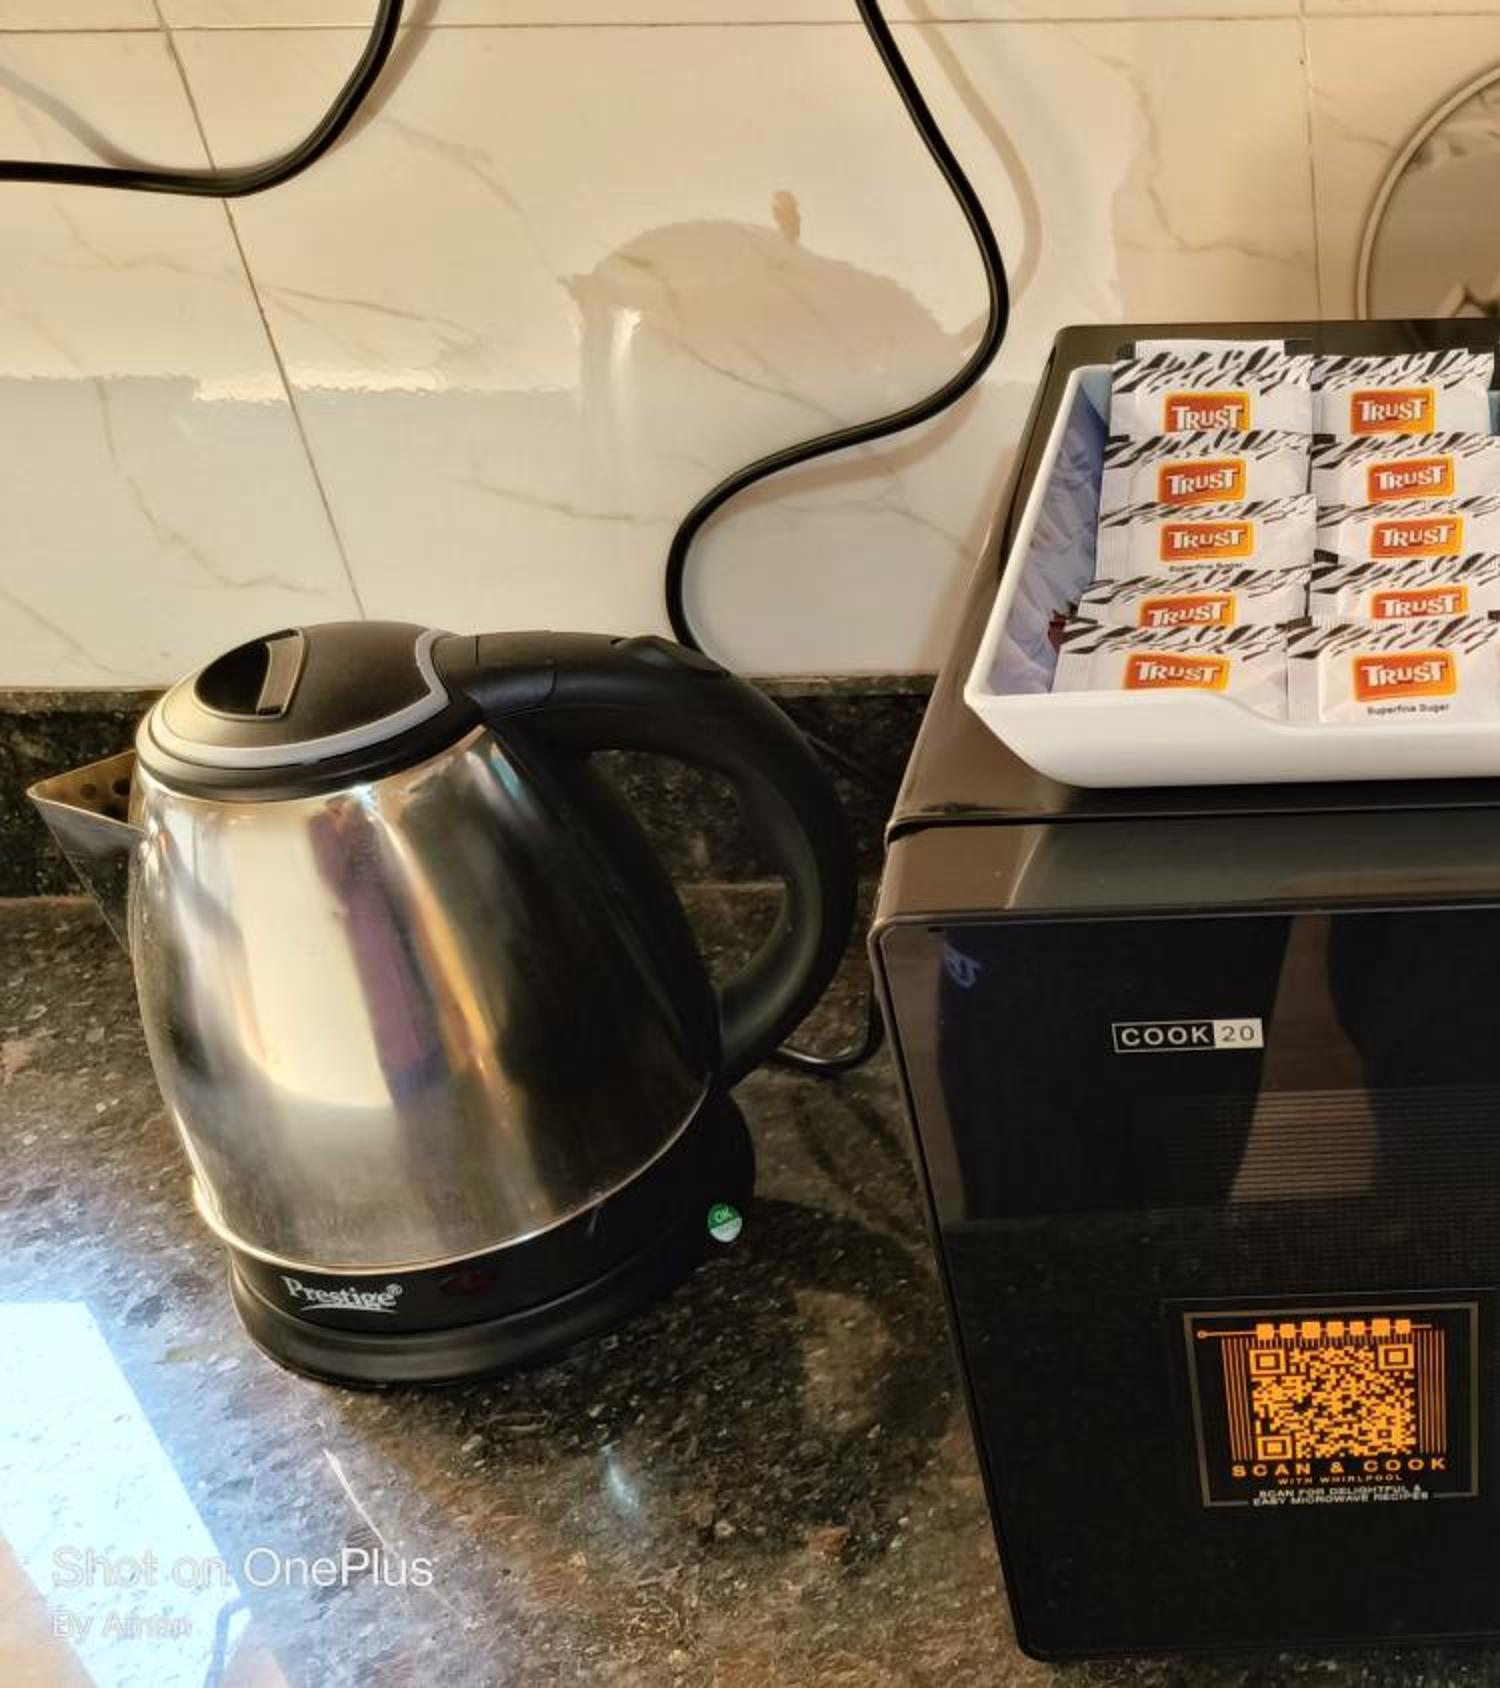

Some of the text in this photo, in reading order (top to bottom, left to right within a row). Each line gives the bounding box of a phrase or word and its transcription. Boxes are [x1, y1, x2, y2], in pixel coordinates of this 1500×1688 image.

[1171, 405, 1243, 430] TRUST
[1357, 398, 1428, 422] TRUST
[1168, 468, 1238, 495] TRUST
[1374, 465, 1446, 490] TRUST
[1168, 529, 1245, 549] TRUST
[1379, 524, 1454, 547] TRUST
[1148, 601, 1228, 627] TRUST
[1378, 594, 1460, 617] TRUST
[1136, 661, 1220, 684] TRUST
[1362, 661, 1445, 687] TRUST
[1120, 1025, 1255, 1046] COOK 20
[1232, 1458, 1446, 1477] SCAN & COOK
[1278, 1474, 1403, 1486] WITH WHIRLPOOL
